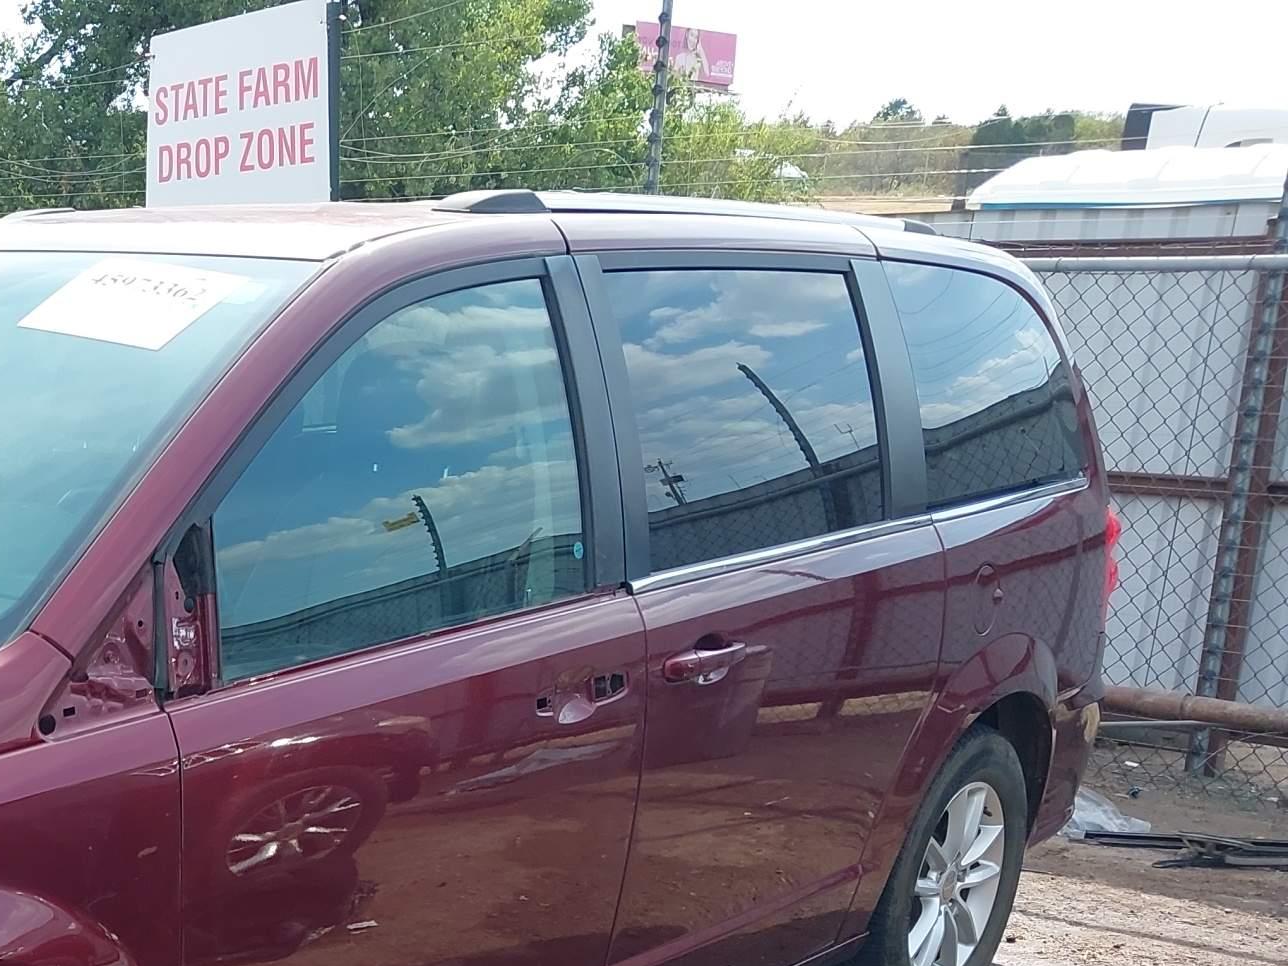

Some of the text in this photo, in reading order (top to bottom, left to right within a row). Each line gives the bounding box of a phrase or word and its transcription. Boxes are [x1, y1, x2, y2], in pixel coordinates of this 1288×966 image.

[155, 57, 318, 126] STATE FARM
[158, 122, 315, 183] DROP ZONE
